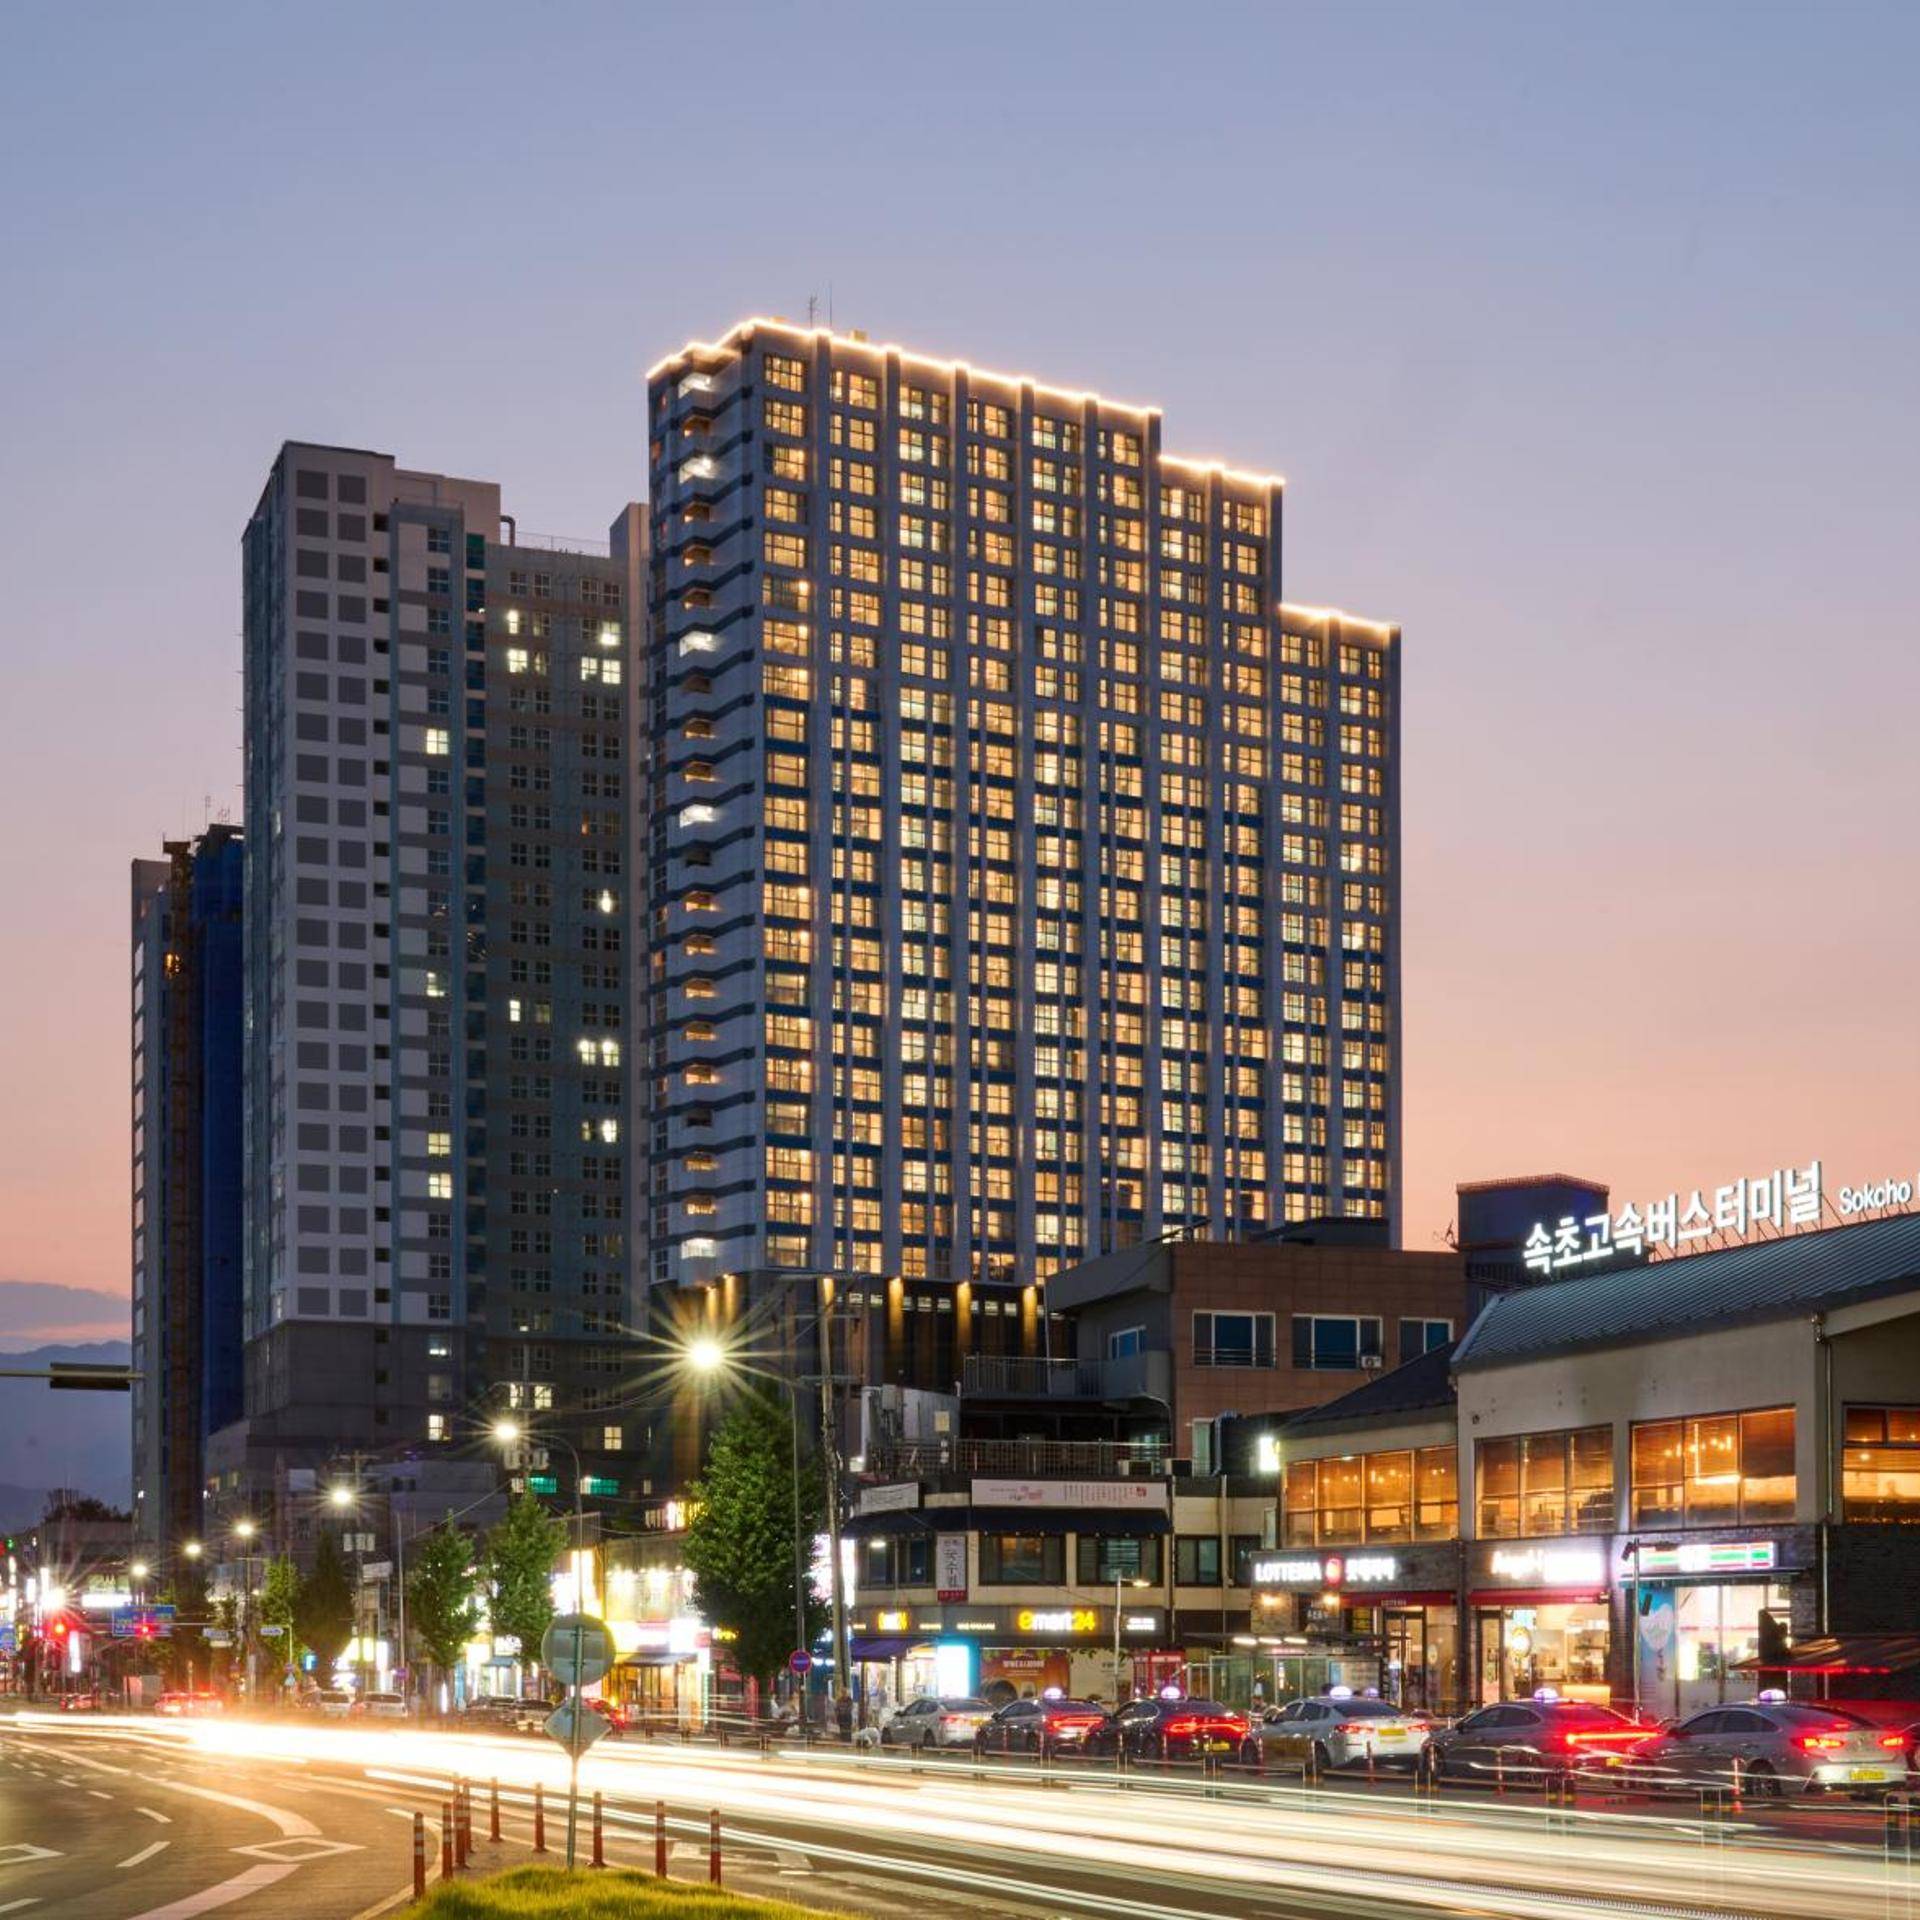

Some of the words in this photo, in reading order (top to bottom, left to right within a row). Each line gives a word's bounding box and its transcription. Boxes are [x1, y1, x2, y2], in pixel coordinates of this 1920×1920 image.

[1839, 1178, 1914, 1215] Sokcho
[1522, 1160, 1822, 1275] 속초고속버스터미널
[1254, 1561, 1322, 1582] LOTTERIA
[1018, 1610, 1096, 1631] emart24
